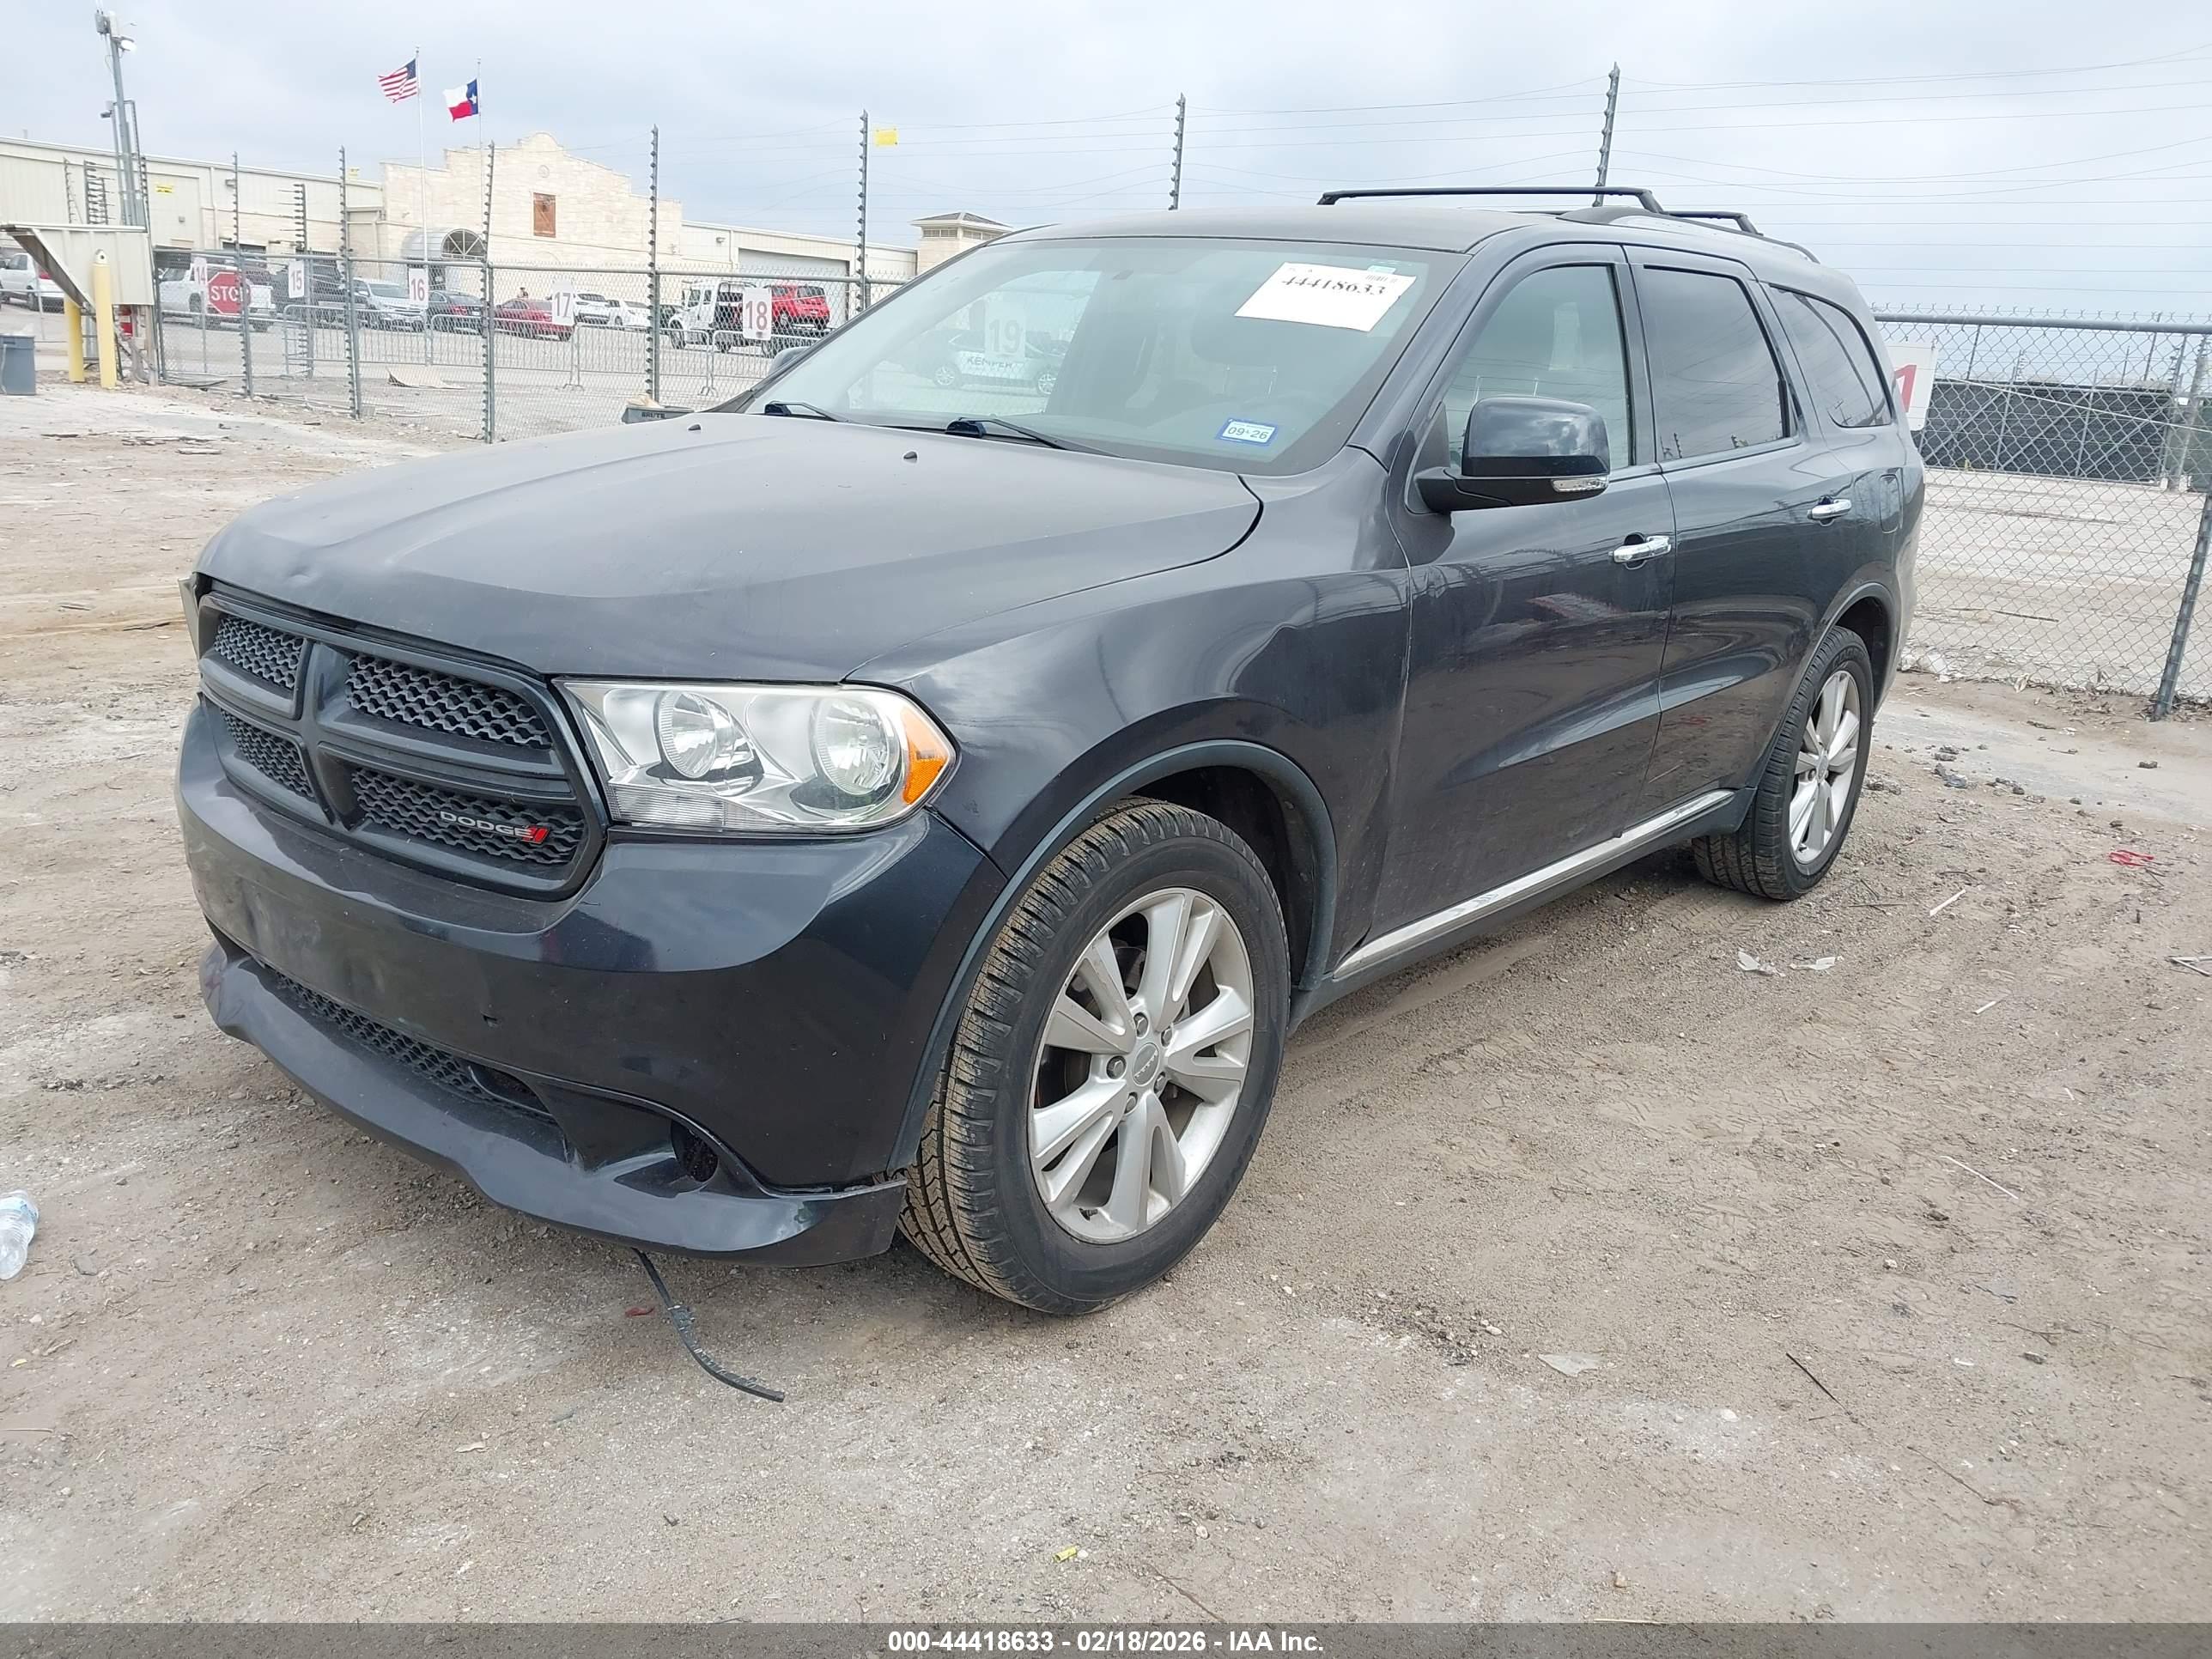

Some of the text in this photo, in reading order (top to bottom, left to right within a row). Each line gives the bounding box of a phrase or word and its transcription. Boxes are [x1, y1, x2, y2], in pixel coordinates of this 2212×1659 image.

[194, 266, 206, 285] 14
[290, 270, 302, 291] 15
[1282, 276, 1386, 295] 44418633
[410, 278, 425, 301] 16
[554, 292, 571, 317] 17
[745, 301, 768, 331] 18
[988, 319, 1020, 354] 19
[1894, 364, 1917, 413] 1
[440, 811, 534, 839] DODGE
